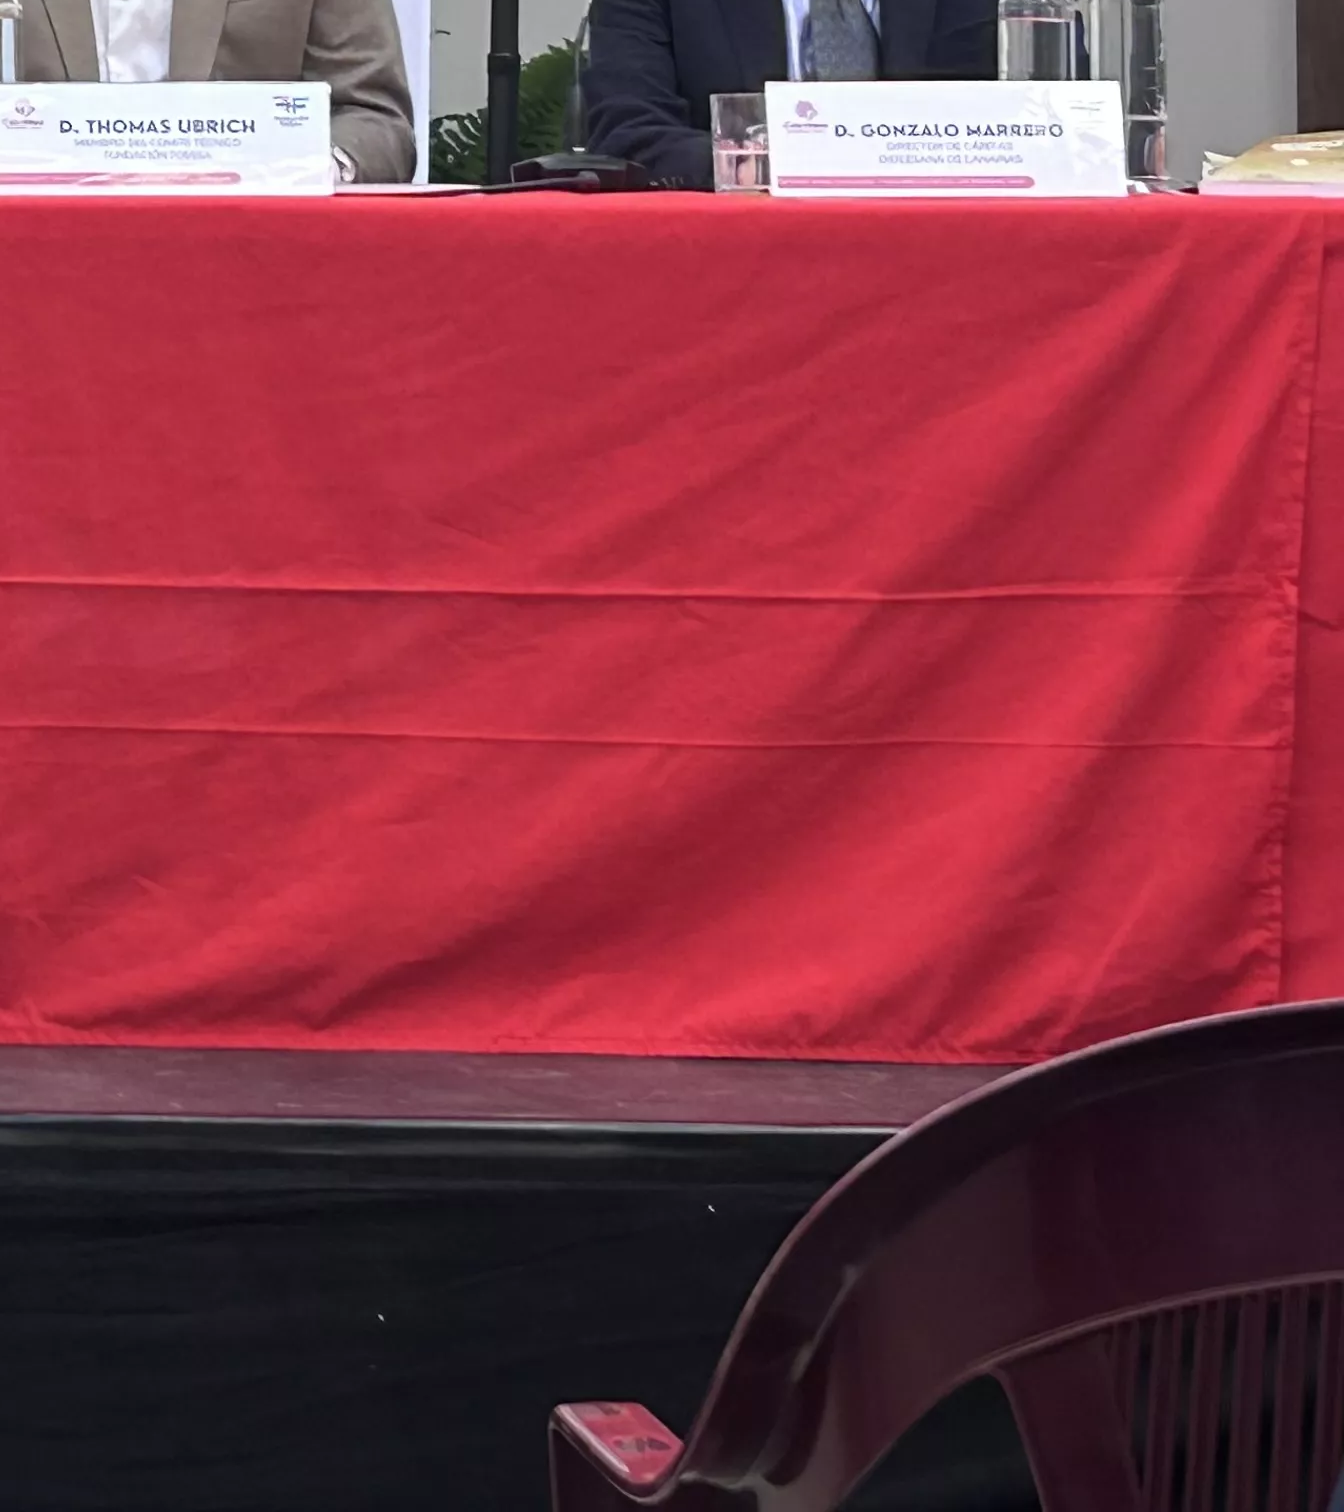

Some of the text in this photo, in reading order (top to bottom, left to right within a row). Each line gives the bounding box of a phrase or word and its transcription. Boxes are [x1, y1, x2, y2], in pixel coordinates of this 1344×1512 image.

[59, 119, 80, 134] D.
[85, 118, 172, 134] THOMAS
[178, 118, 256, 134] UBRICH
[835, 123, 855, 138] D.
[860, 123, 960, 138] GONZALO
[966, 123, 1064, 138] MARRERO
